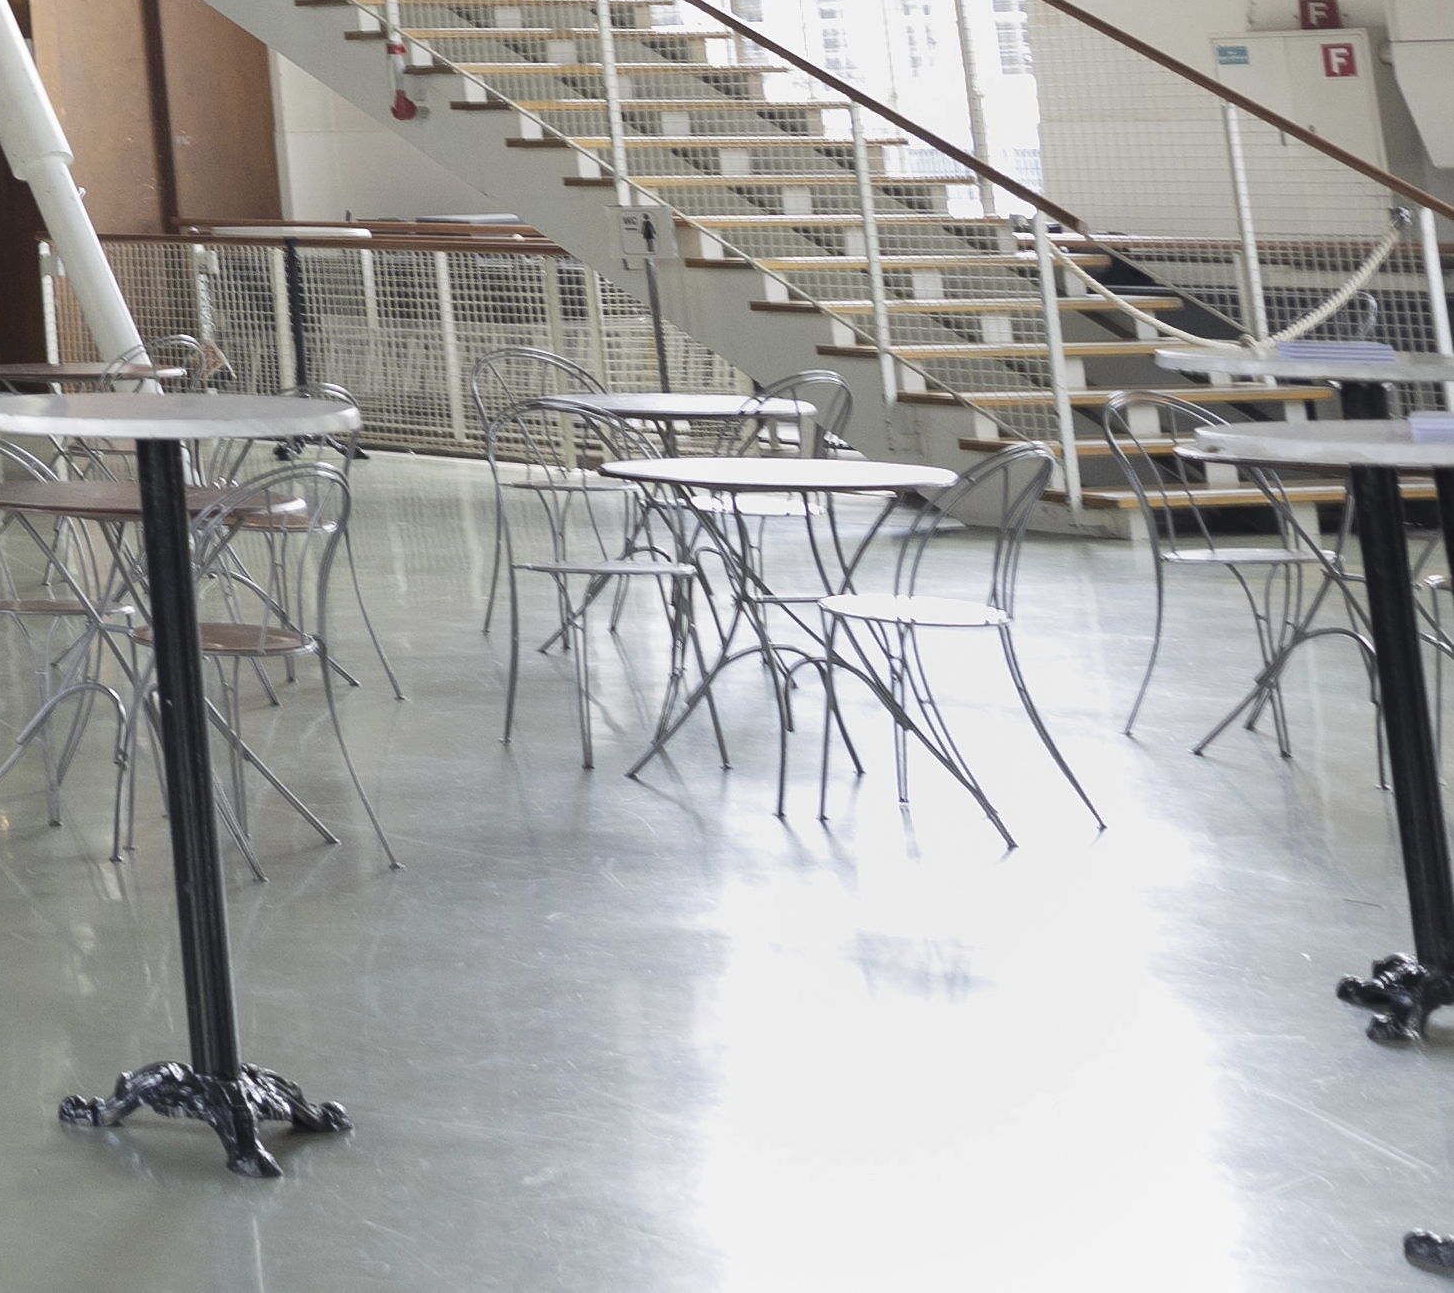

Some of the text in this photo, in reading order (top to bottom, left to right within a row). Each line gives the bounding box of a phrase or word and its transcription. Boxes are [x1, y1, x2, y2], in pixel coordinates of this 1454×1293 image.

[1306, 2, 1329, 25] F
[1327, 47, 1350, 75] F
[622, 216, 638, 225] WC
